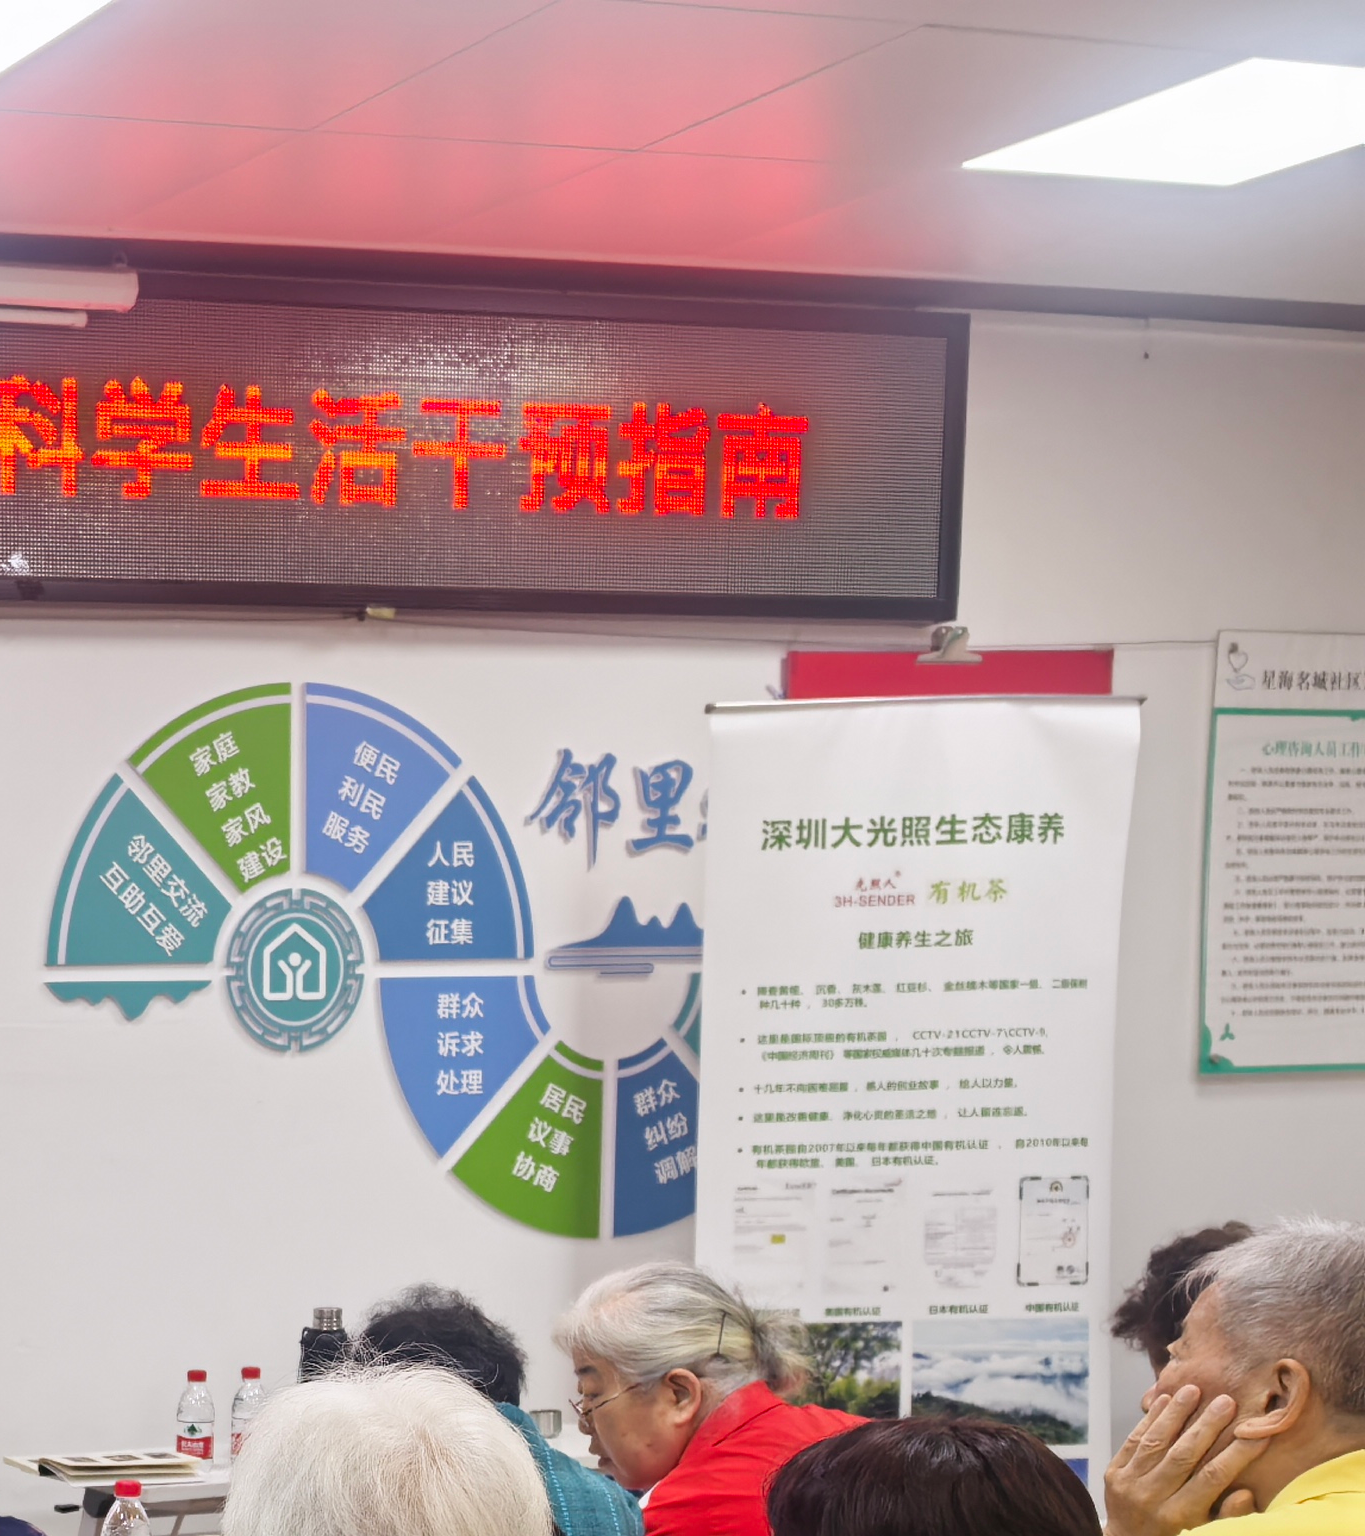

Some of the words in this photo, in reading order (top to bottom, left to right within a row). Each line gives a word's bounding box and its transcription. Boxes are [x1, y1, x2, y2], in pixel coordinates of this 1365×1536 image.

[1262, 669, 1365, 691] 星海名城社区
[189, 731, 240, 777] 家庭
[353, 741, 402, 786] 便民
[1262, 740, 1365, 758] 心理咨询人员工作
[205, 767, 257, 813] 家教
[338, 775, 387, 821] 利民
[221, 802, 272, 848] 家风
[322, 811, 371, 856] 服务
[761, 812, 1065, 851] 深圳大光照生态康养
[236, 837, 288, 884] 建设
[427, 841, 475, 869] 人民
[125, 833, 210, 929] 邻里交流
[427, 880, 474, 908] 建议
[928, 878, 1009, 905] 有机茶
[99, 861, 188, 957] 互助互爱
[833, 894, 916, 908] 3H-SENDER
[426, 918, 474, 947] 征集
[858, 928, 974, 950] 健康养生之旅
[437, 993, 484, 1019] 群众
[437, 1031, 484, 1057] 诉求
[436, 1070, 484, 1096] 处理
[633, 1079, 681, 1117] 群众
[540, 1082, 588, 1125] 居民
[527, 1117, 574, 1157] 议事
[644, 1112, 689, 1151] 纠纷
[511, 1151, 560, 1192] 协商
